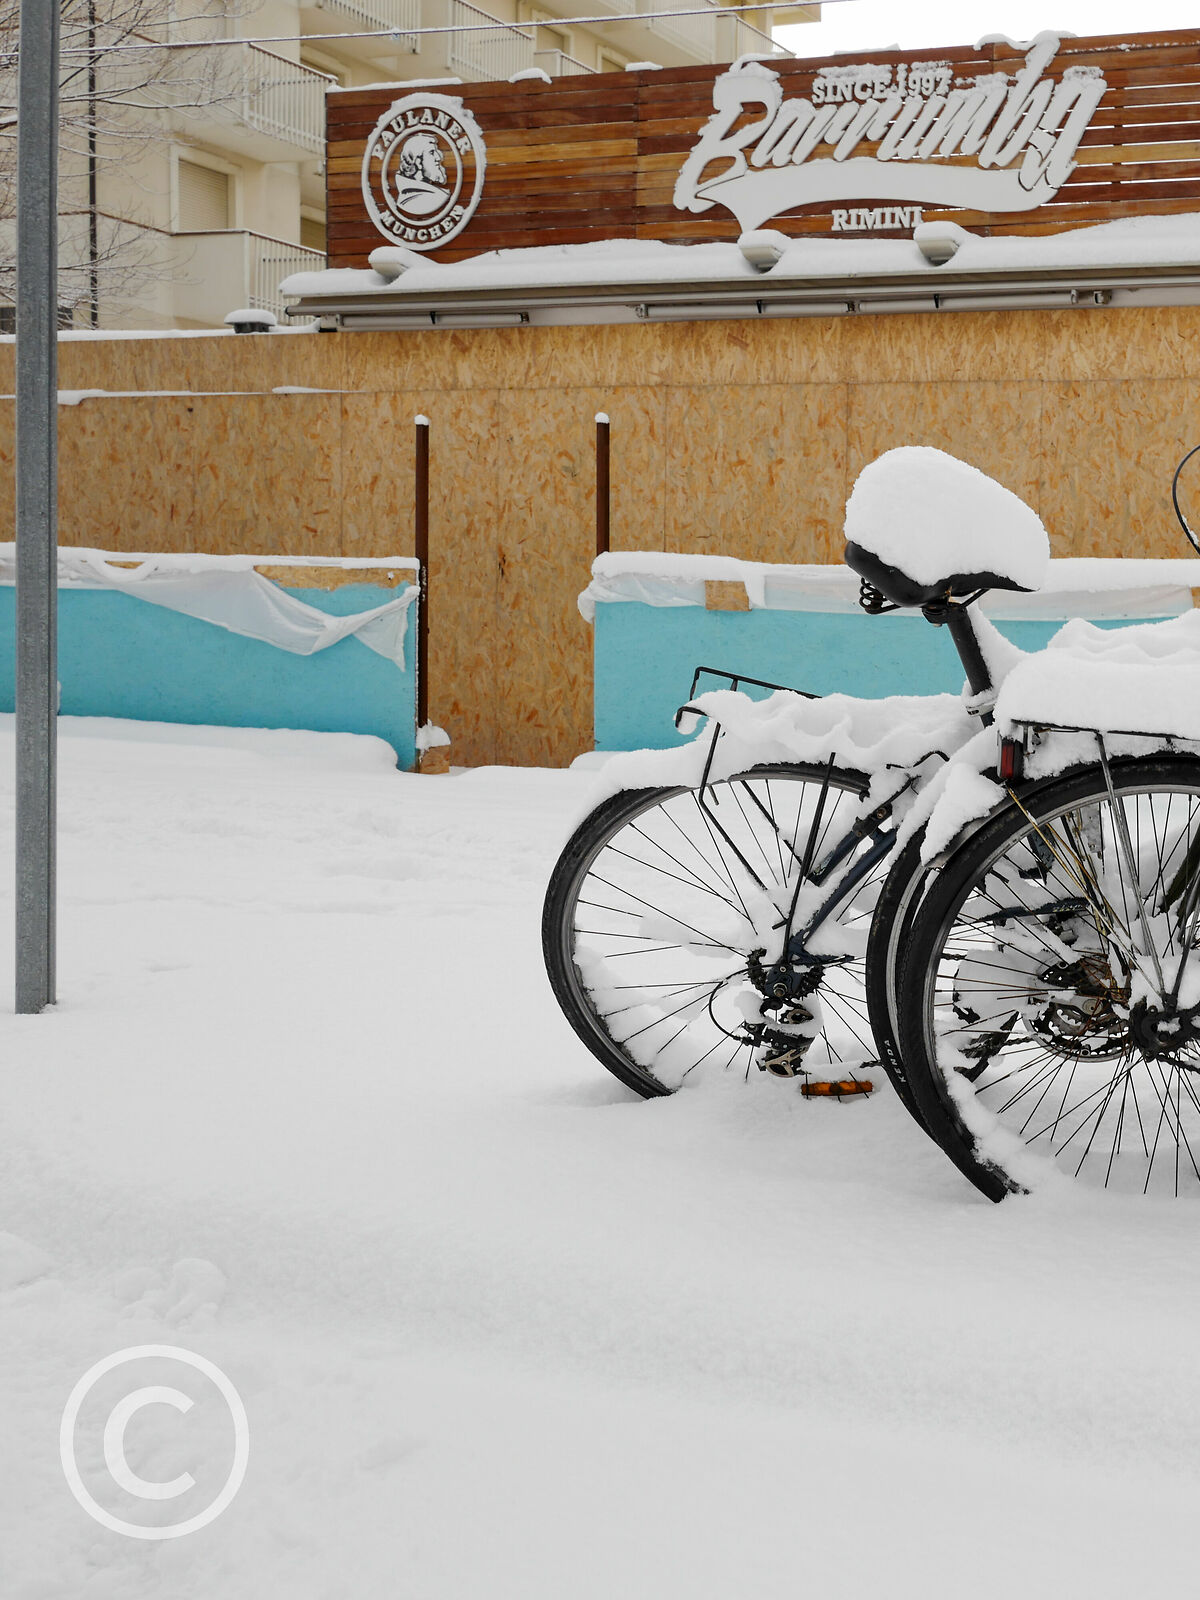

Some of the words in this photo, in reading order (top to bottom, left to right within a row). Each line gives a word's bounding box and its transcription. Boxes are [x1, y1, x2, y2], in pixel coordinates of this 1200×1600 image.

[812, 71, 892, 104] SINCE
[896, 66, 953, 98] 1997
[372, 108, 472, 160] PAULANER
[379, 204, 467, 241] MUNCHEN
[831, 206, 924, 231] RIMINI
[884, 1039, 907, 1083] KENDA
